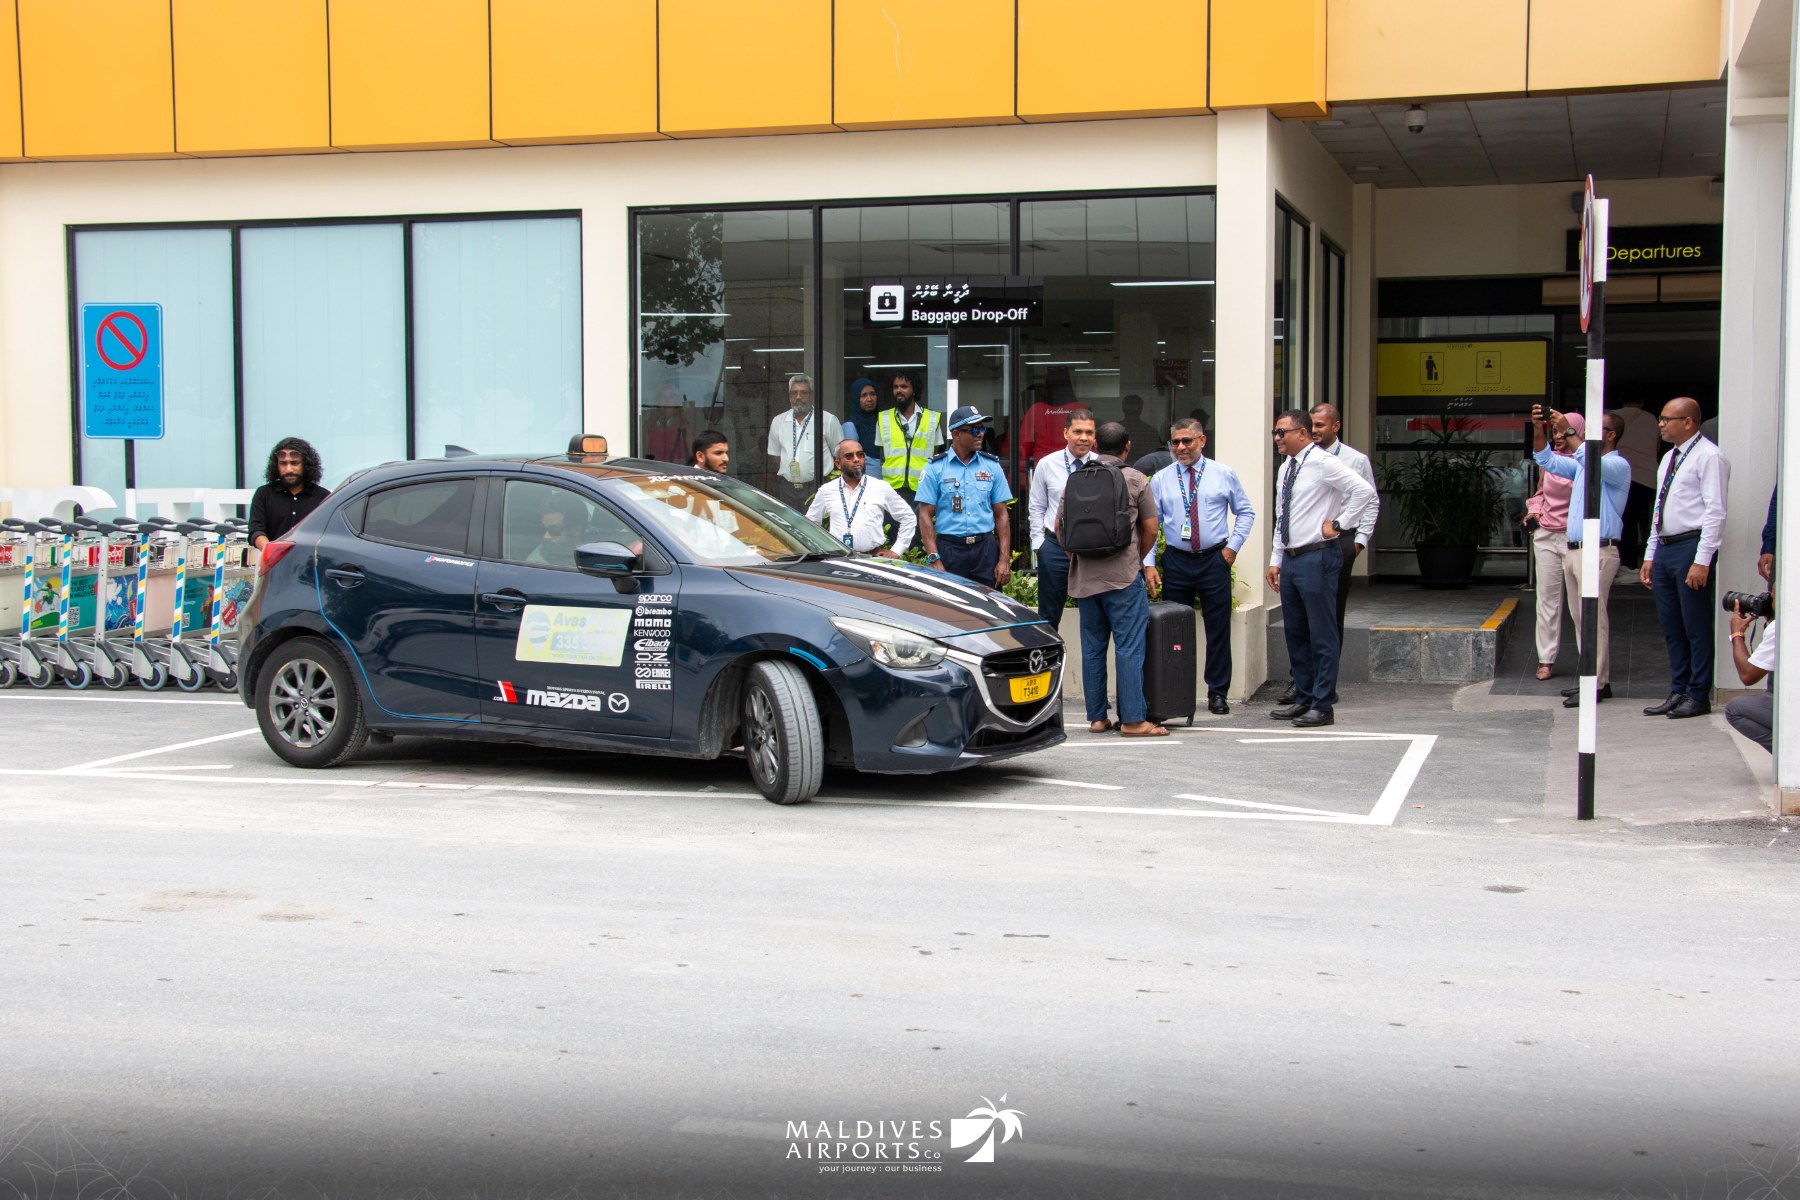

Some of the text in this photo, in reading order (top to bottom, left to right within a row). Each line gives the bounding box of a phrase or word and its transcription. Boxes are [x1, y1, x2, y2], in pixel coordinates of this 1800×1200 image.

[1606, 244, 1702, 263] Departures
[911, 308, 1028, 324] Baggage Drop-Off
[637, 594, 673, 604] sparco
[644, 607, 673, 615] brembo
[553, 612, 587, 628] Avas
[634, 618, 672, 627] momo
[633, 629, 671, 637] KENWOOD
[651, 668, 671, 678] ENKEI
[635, 679, 672, 690] PIRELLI
